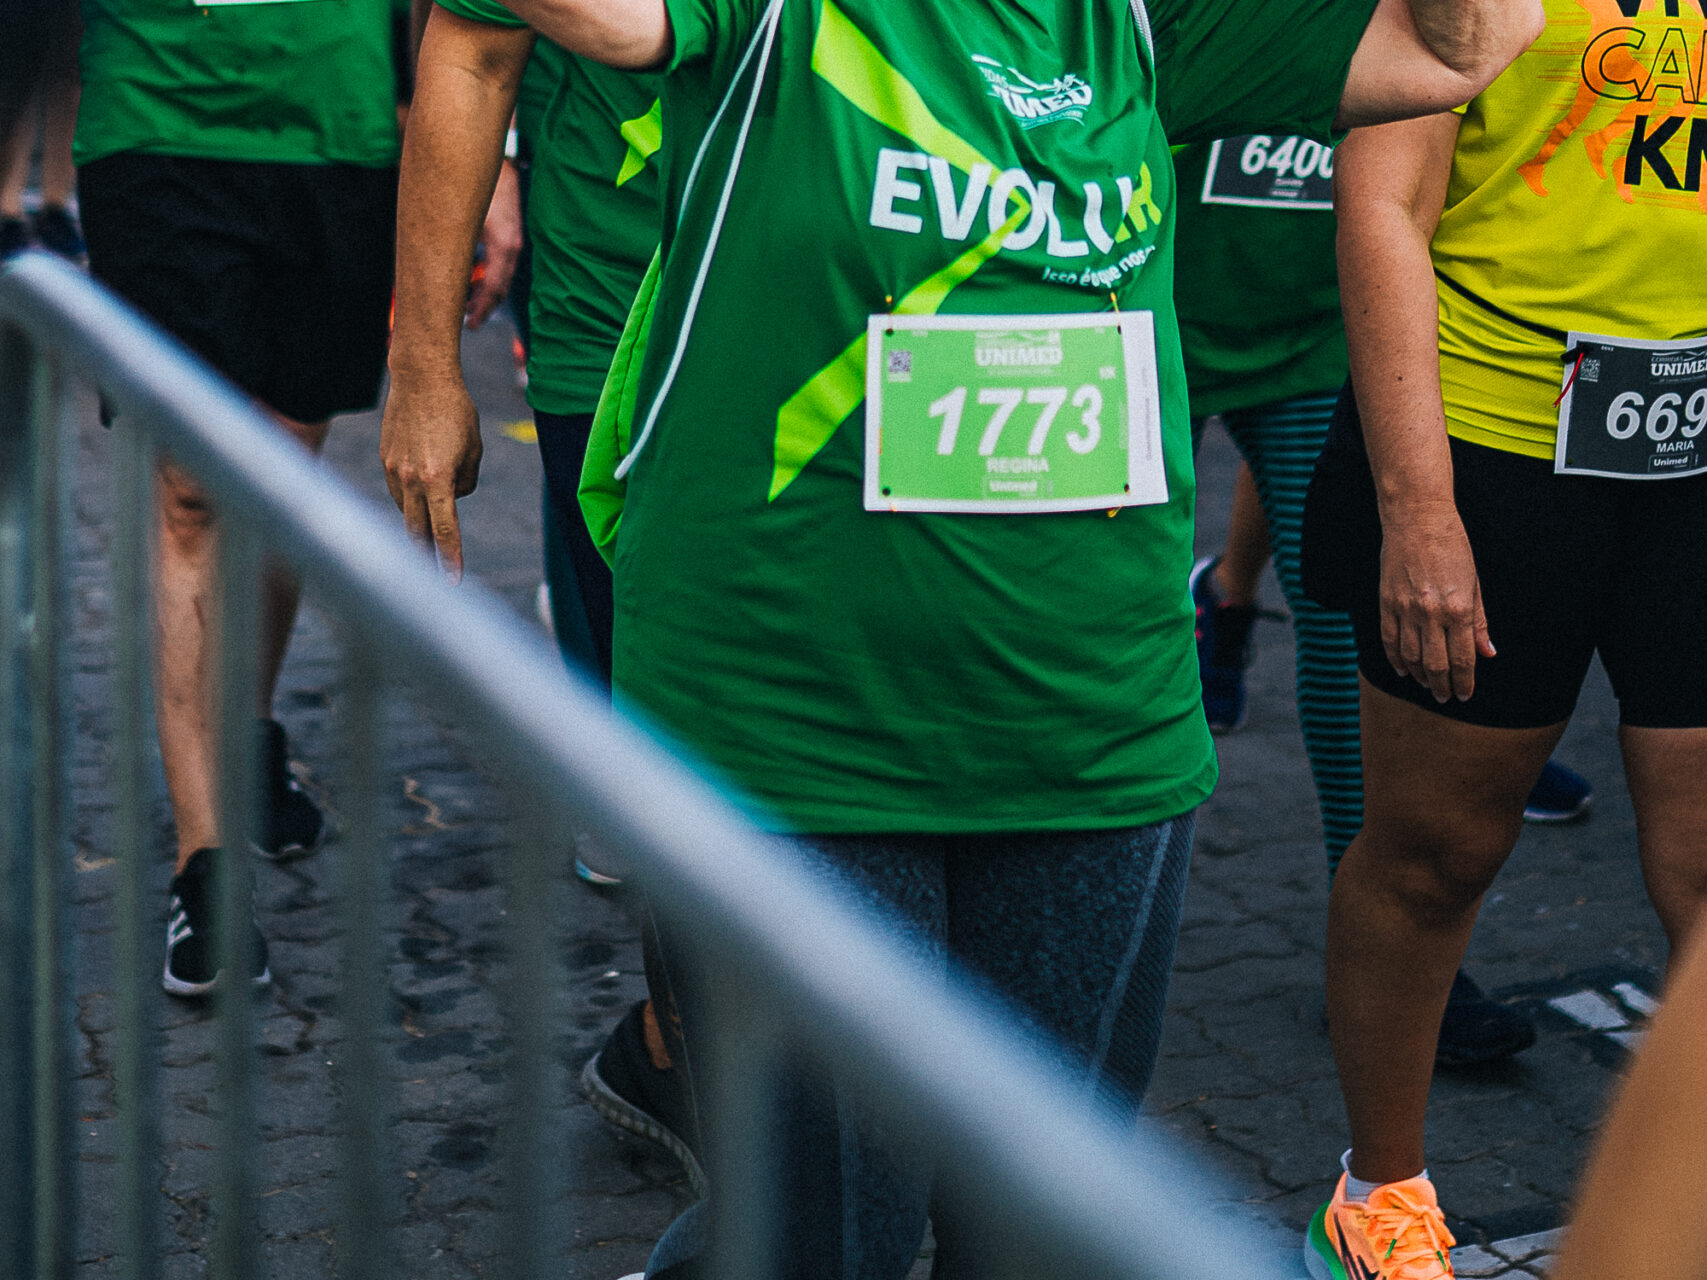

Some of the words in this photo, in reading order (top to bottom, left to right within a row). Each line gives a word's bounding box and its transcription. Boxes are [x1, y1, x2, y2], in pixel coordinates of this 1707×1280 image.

[1581, 26, 1707, 105] CA
[991, 84, 1092, 119] IMED
[974, 346, 1063, 367] UNIMED
[1651, 359, 1707, 377] UNIME
[928, 383, 1103, 456] 1773
[1656, 439, 1695, 454] MARIA
[986, 455, 1050, 474] REGINA
[1653, 455, 1689, 467] Unimed
